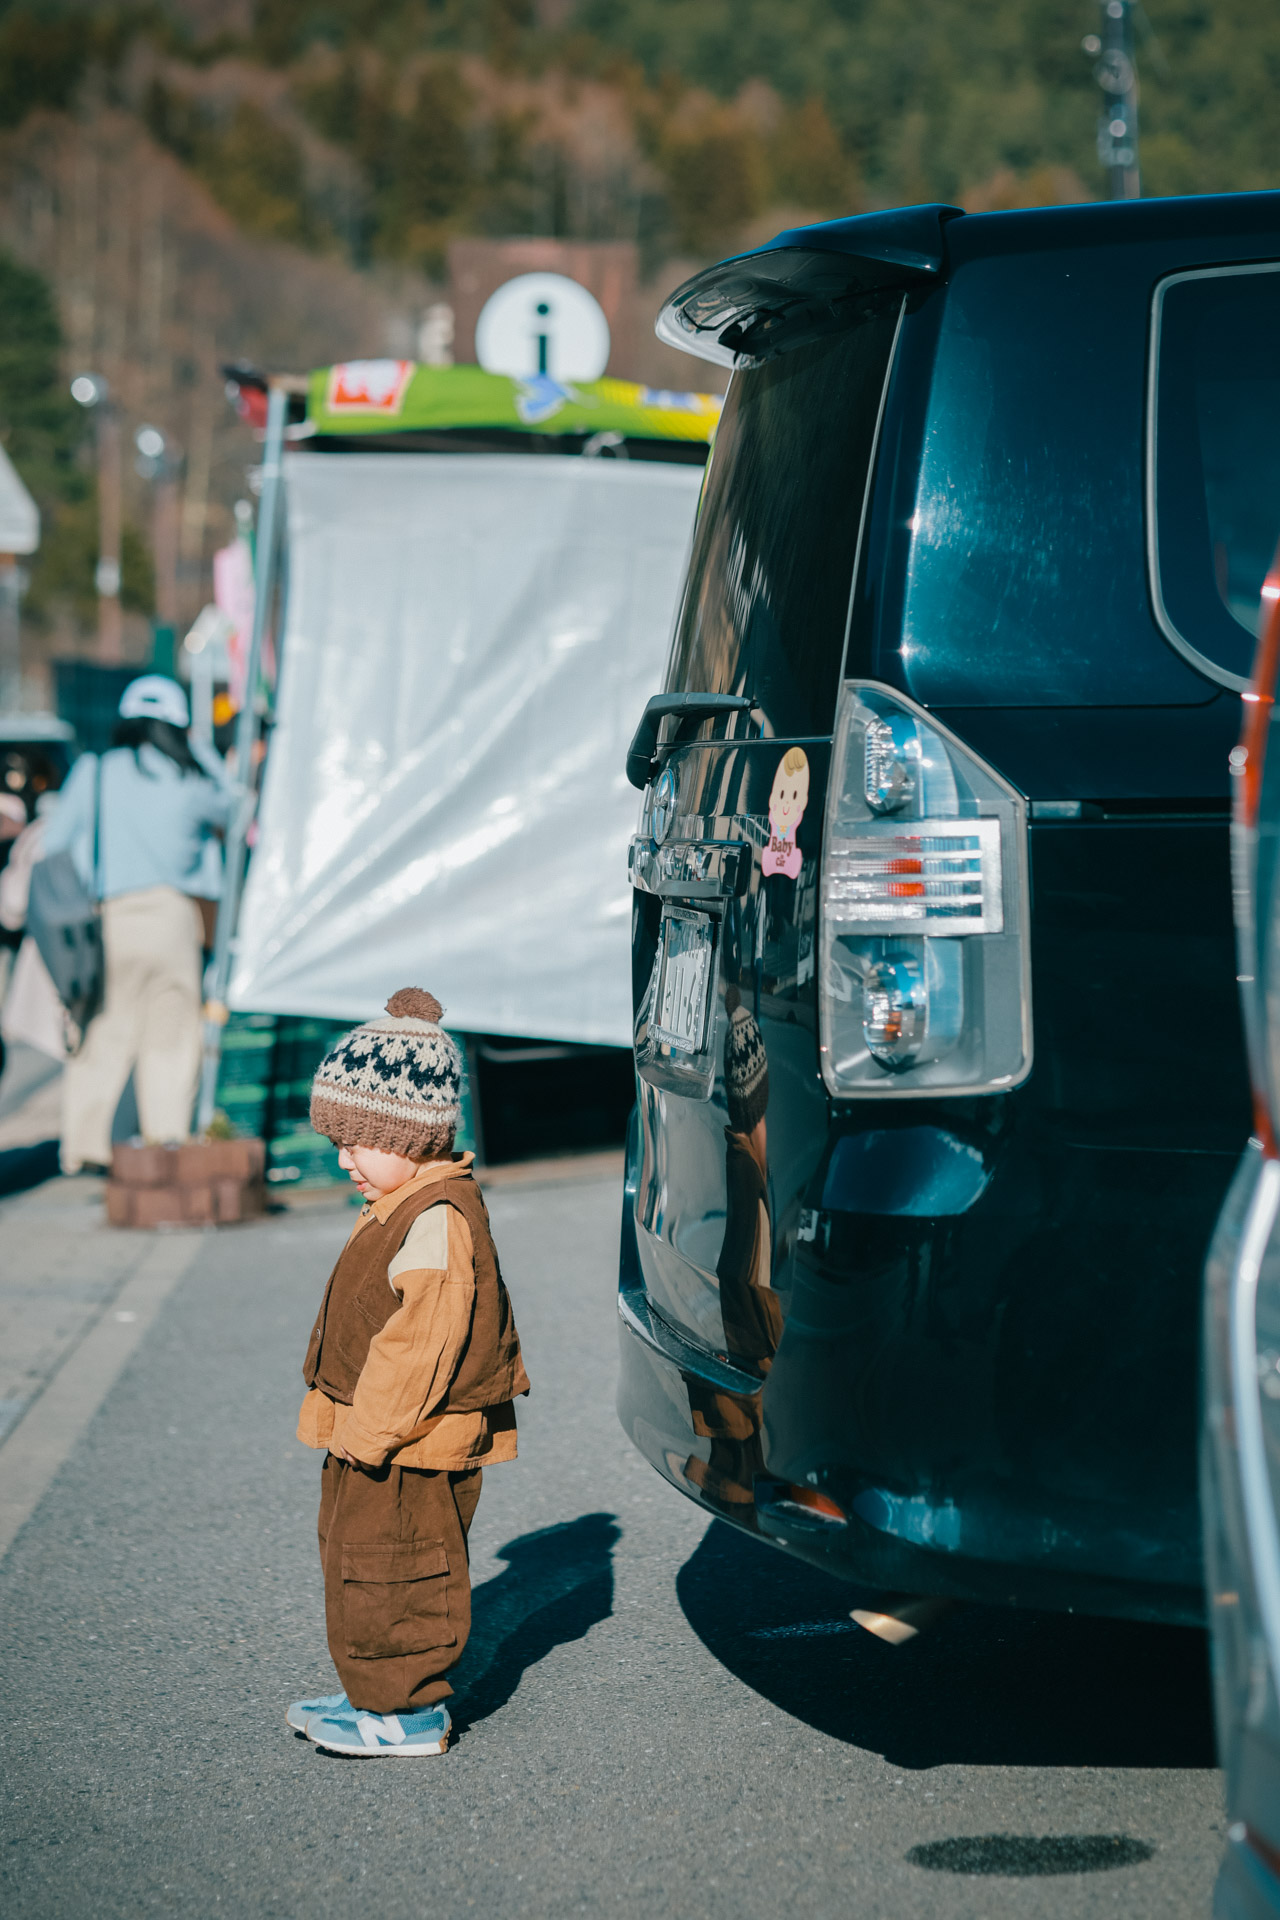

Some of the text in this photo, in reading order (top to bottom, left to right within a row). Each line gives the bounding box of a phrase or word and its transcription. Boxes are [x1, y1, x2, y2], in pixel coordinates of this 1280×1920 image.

[537, 304, 549, 376] i
[771, 836, 794, 857] Baby
[356, 1713, 407, 1747] N
